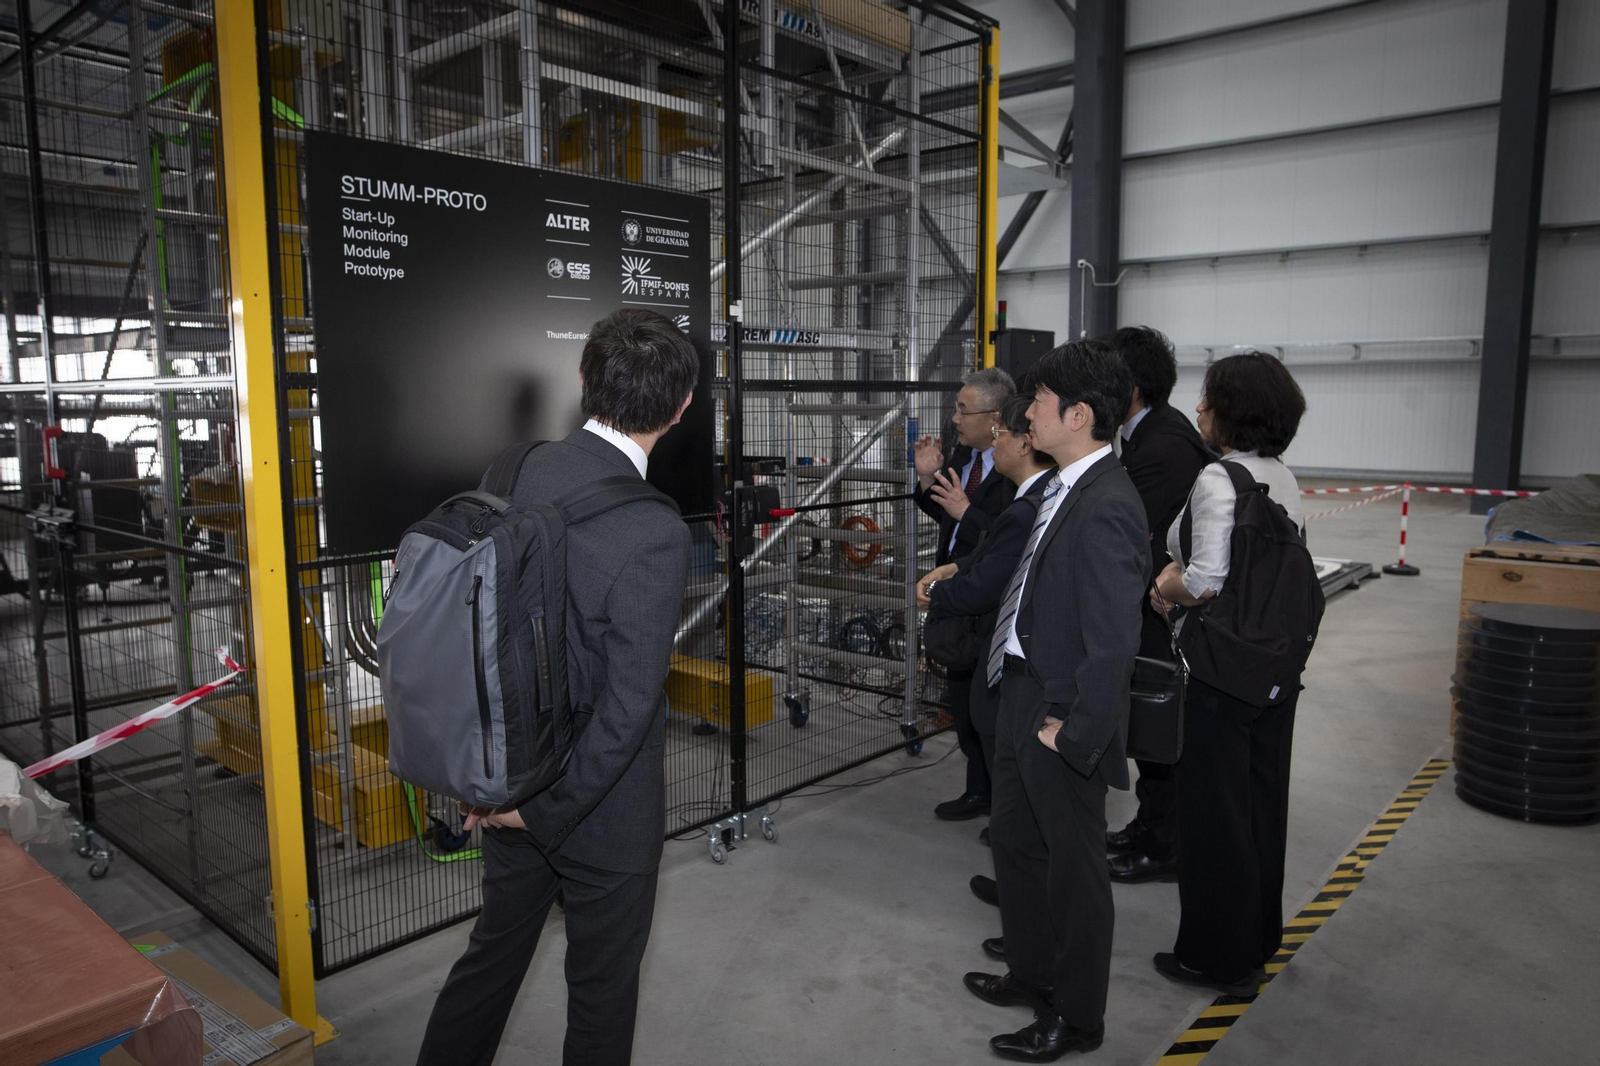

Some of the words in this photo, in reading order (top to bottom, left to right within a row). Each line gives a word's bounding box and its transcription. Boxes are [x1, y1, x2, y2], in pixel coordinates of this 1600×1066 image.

[341, 175, 488, 212] STUMM-PROTO
[342, 207, 396, 227] Start-Up
[545, 213, 591, 233] ALTER
[343, 225, 408, 247] Monitoring
[645, 226, 690, 239] UNIVERSIDAD
[343, 243, 391, 260] Module
[344, 261, 405, 280] Prototype
[566, 262, 591, 275] ESS
[641, 279, 690, 292] IFMIF-DONES
[641, 288, 690, 300] ESPAÑA
[796, 331, 821, 344] ASC
